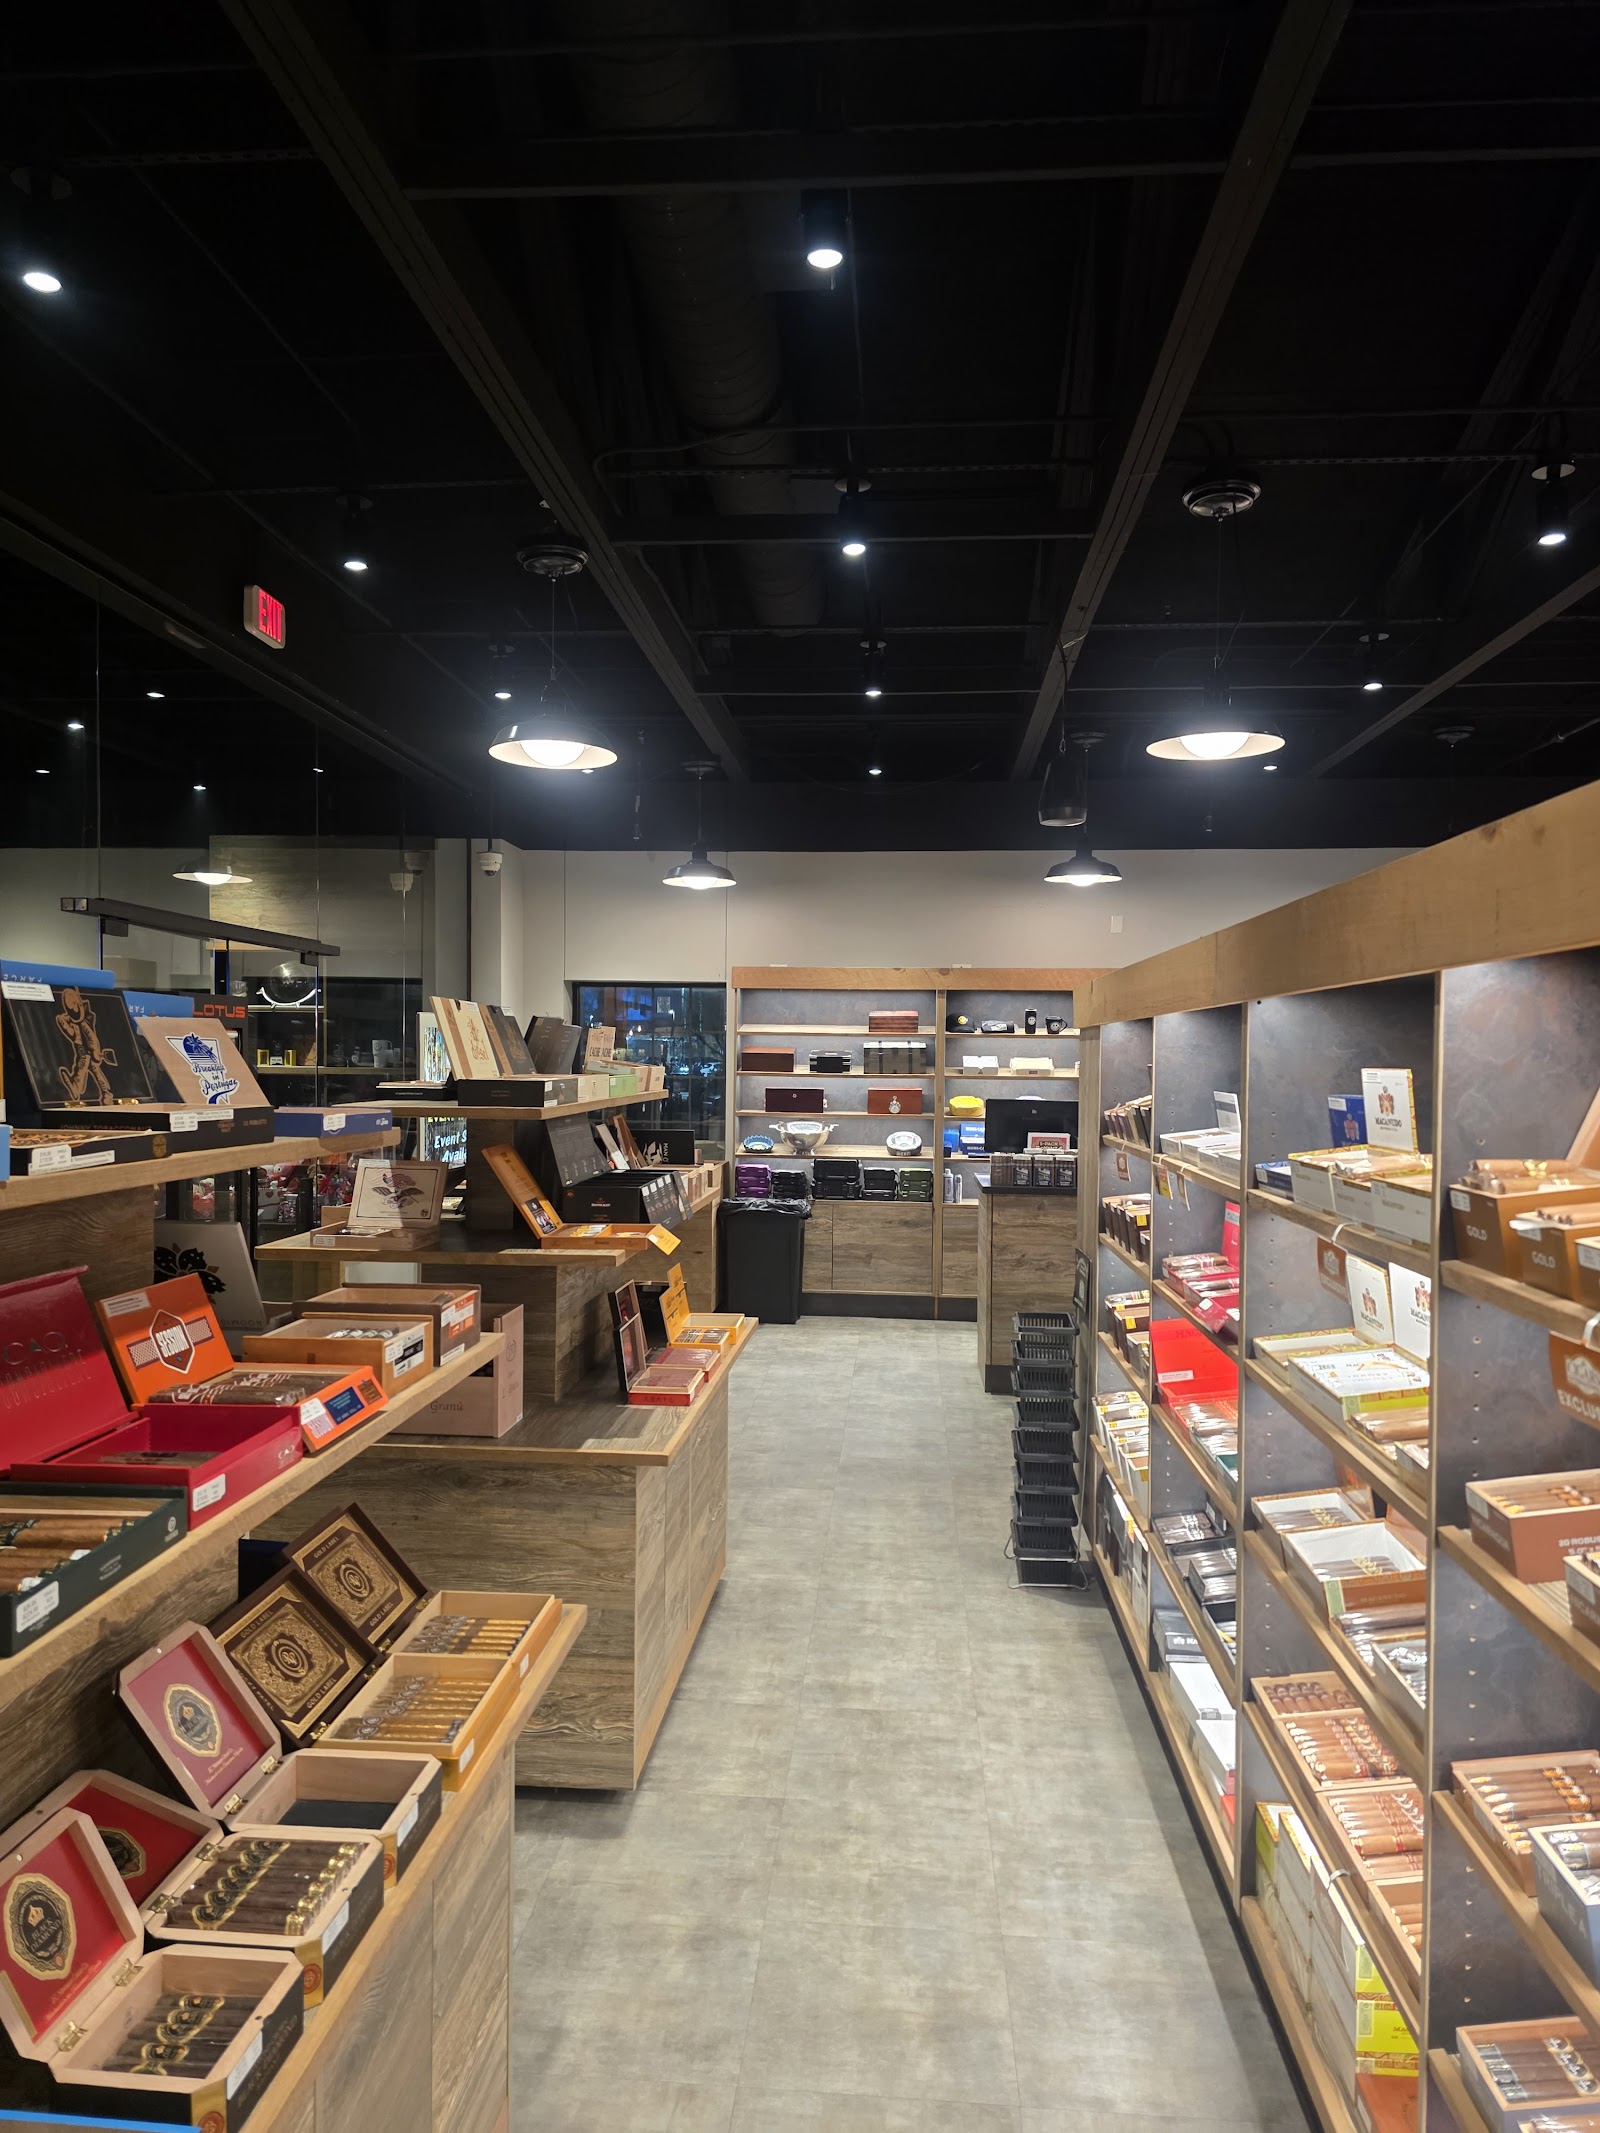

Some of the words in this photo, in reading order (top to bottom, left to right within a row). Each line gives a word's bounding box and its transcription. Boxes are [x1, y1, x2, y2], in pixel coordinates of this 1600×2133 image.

[258, 589, 283, 643] EXIT
[192, 1004, 246, 1018] LOTUS
[1374, 1117, 1403, 1128] MACANUDO
[434, 1130, 460, 1149] Event
[1466, 1225, 1488, 1241] GOLD
[1531, 1251, 1556, 1268] GOLD
[3, 1331, 66, 1366] CAO
[155, 1324, 190, 1358] SESSION
[313, 1544, 328, 1559] GOLD
[326, 1536, 340, 1550] LABEL
[240, 1622, 257, 1639] GOLD
[256, 1610, 274, 1625] LABEL
[369, 1613, 383, 1627] GOLD
[381, 1601, 394, 1616] LABEL
[307, 1693, 322, 1709] GOLD
[320, 1677, 337, 1695] LABEL
[30, 1919, 62, 1952] DIAMOND
[32, 1918, 54, 1941] BLACK
